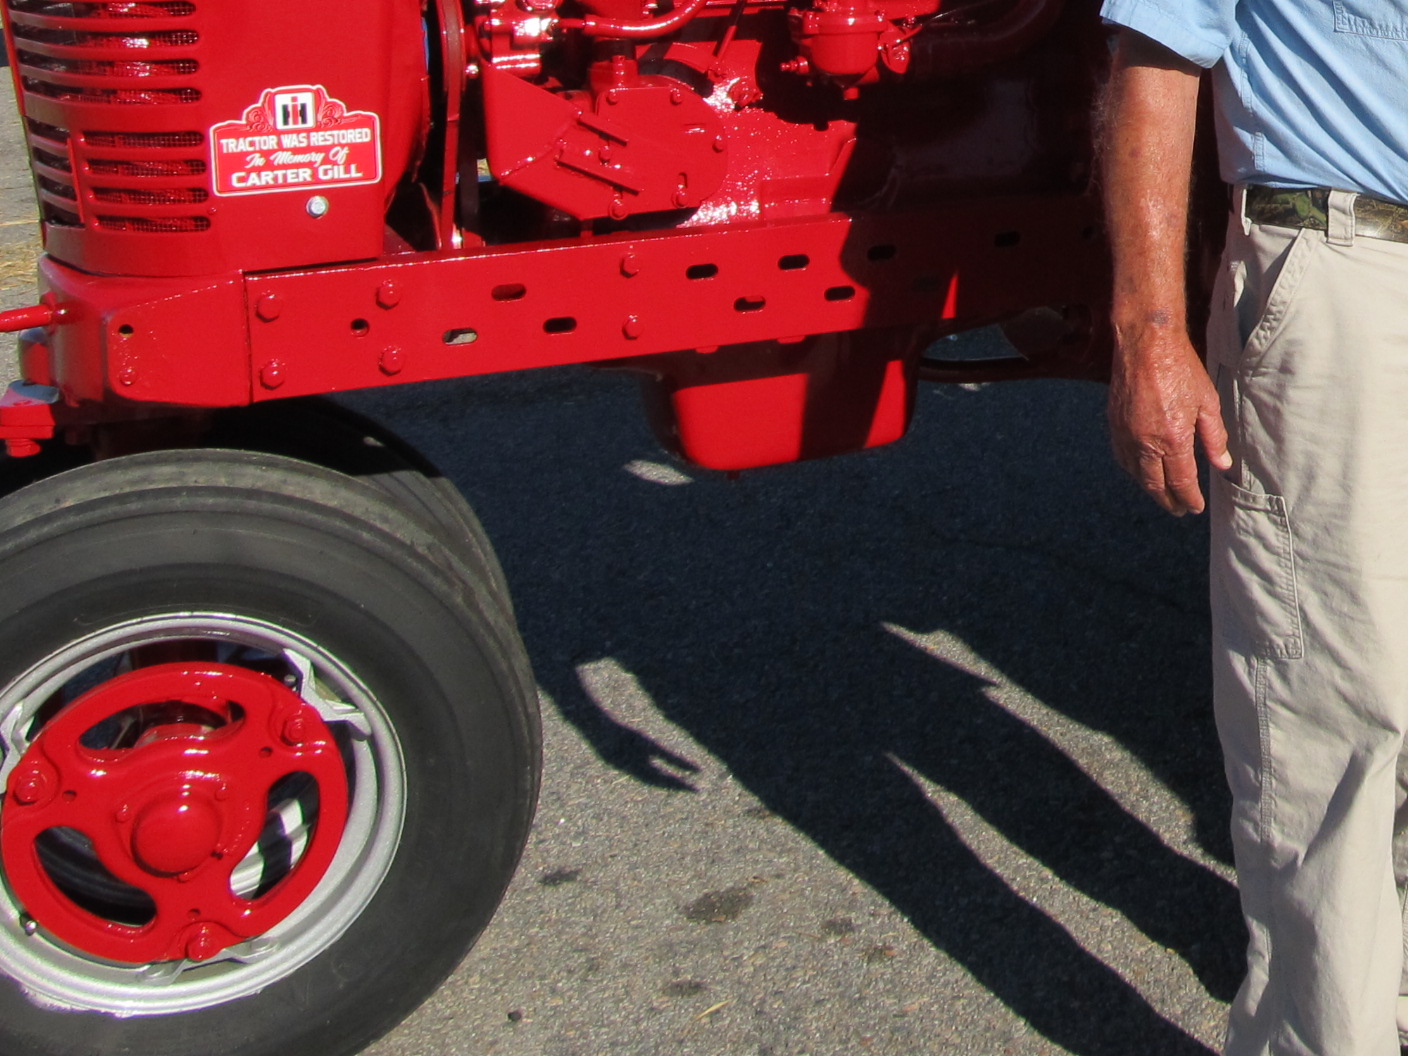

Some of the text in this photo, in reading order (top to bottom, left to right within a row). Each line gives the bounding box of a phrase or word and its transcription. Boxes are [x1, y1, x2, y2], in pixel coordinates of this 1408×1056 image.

[220, 128, 371, 153] TRACTOR WAS RESTORED
[244, 146, 349, 168] In Memory Of
[231, 163, 363, 187] CARTER GILL
